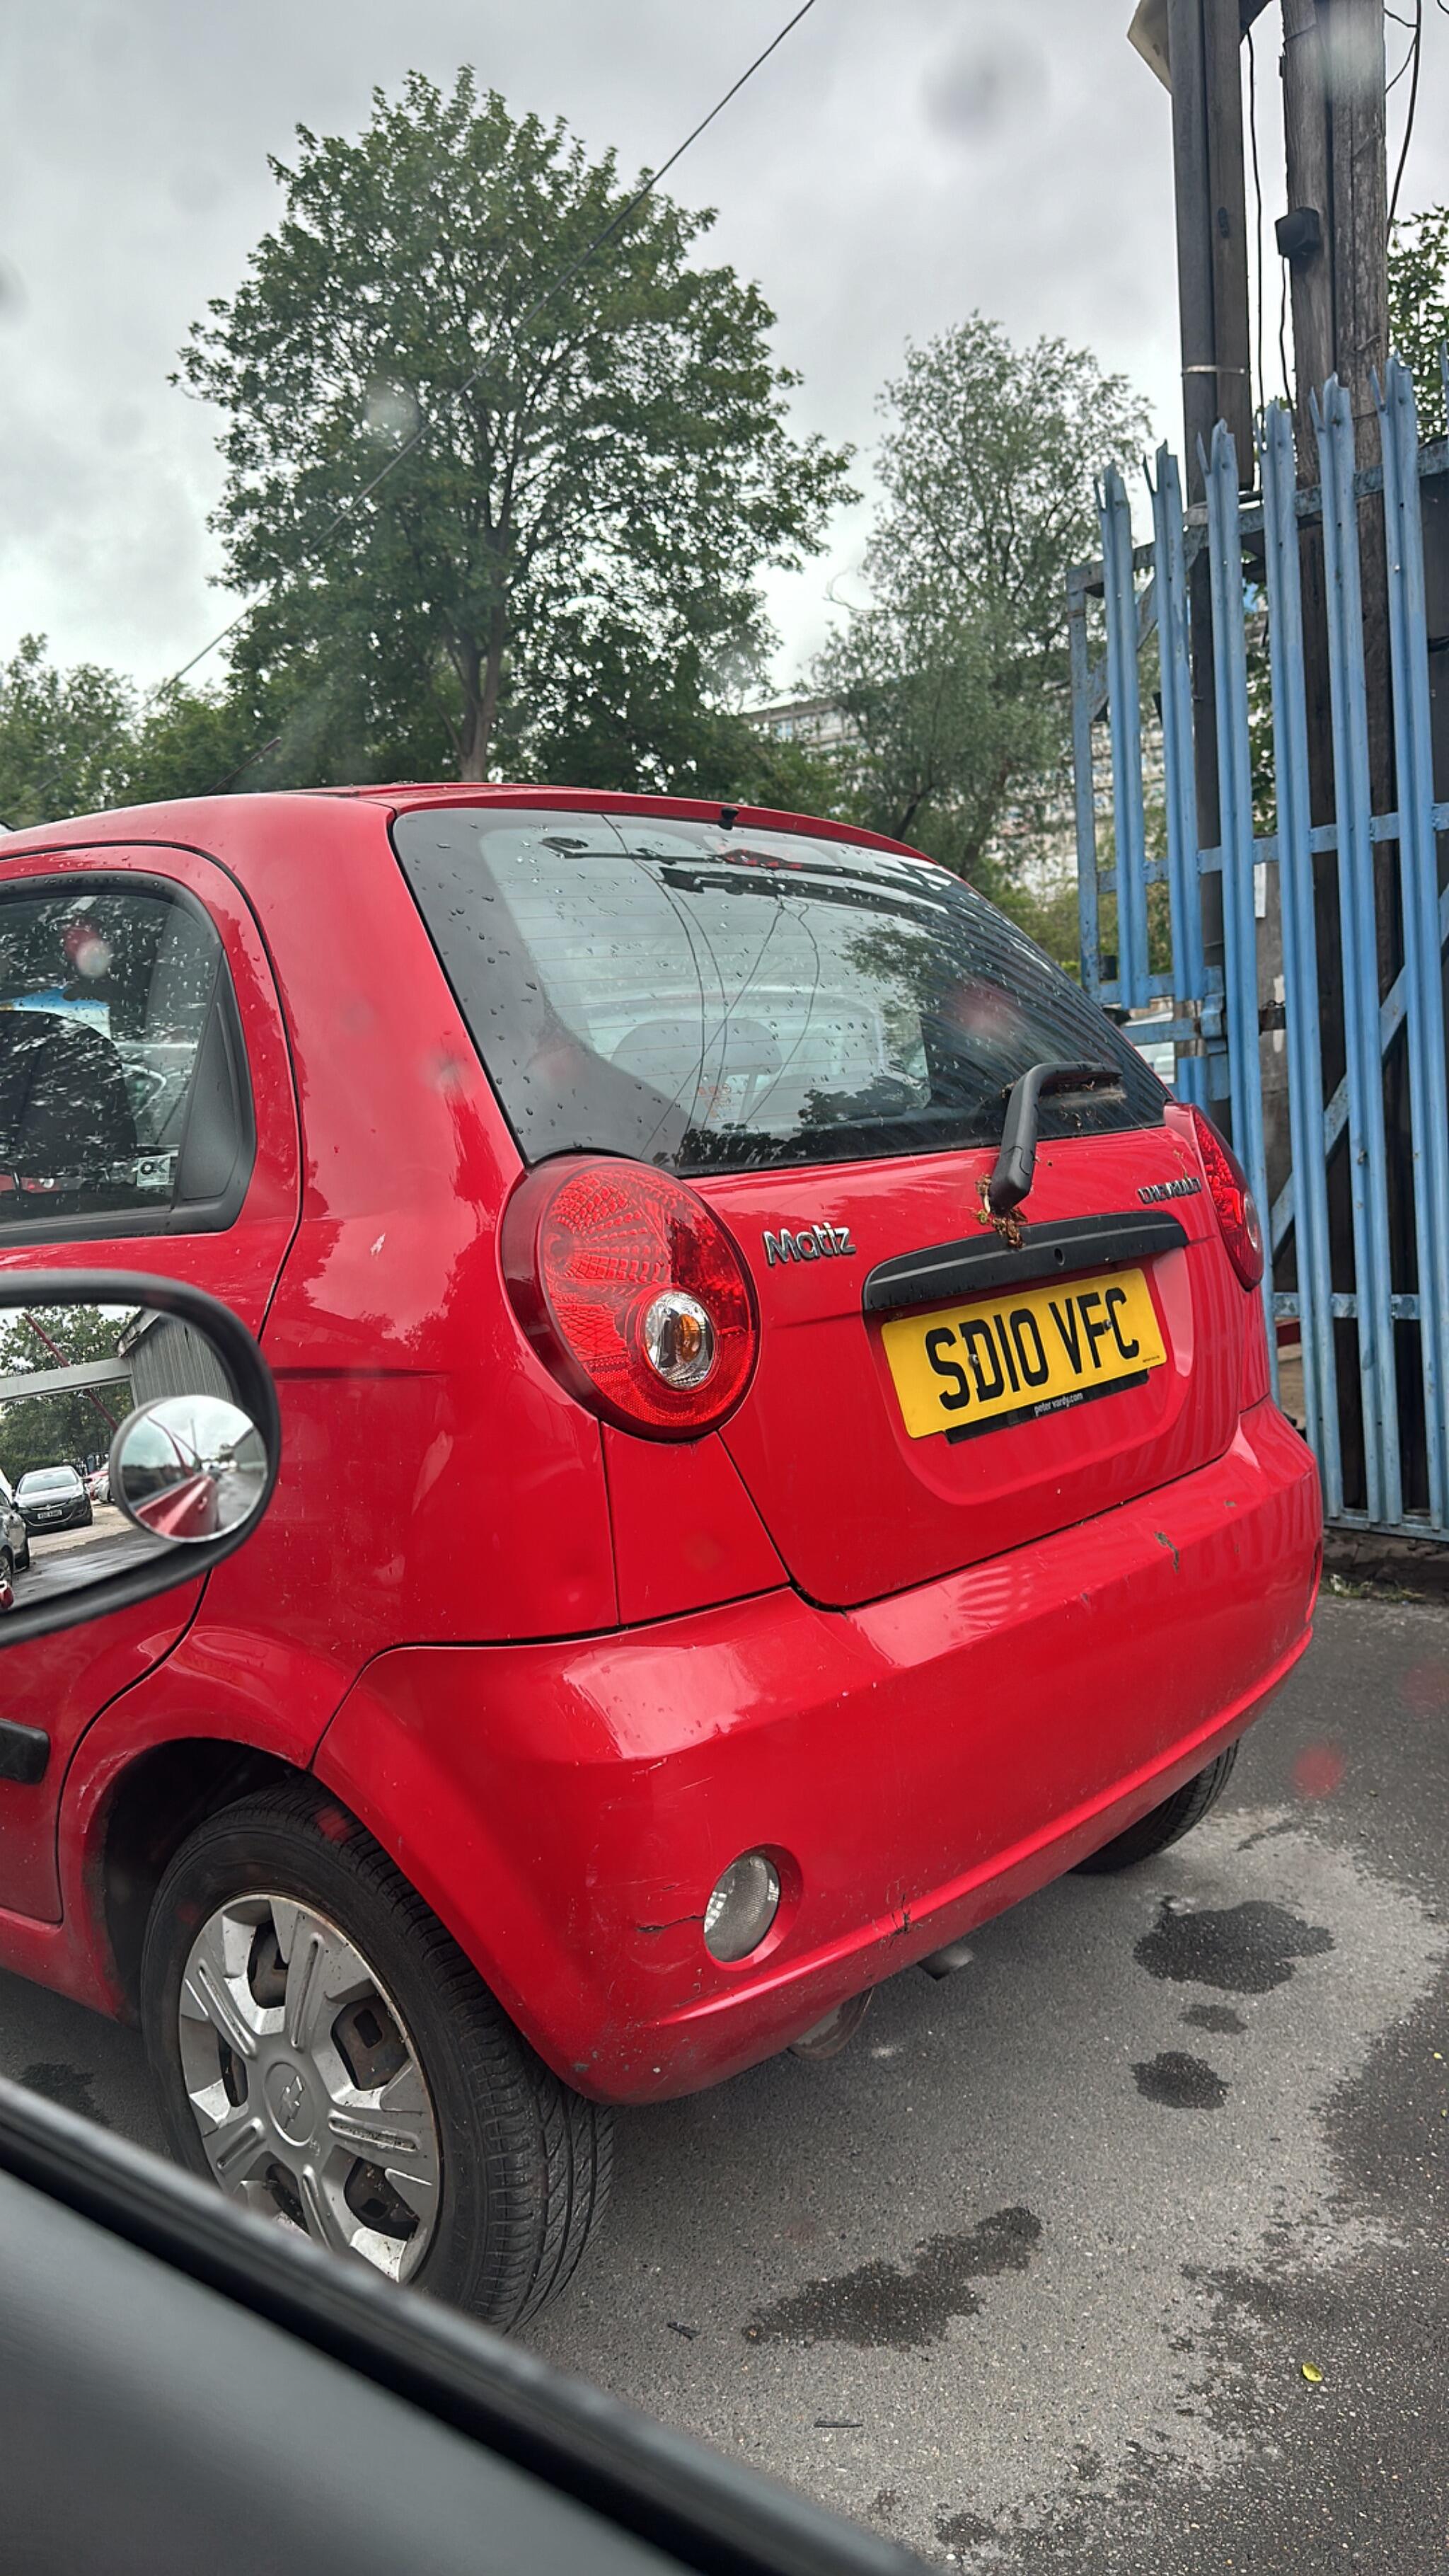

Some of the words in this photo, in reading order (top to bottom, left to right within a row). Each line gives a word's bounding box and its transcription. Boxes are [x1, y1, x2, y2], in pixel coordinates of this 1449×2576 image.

[763, 1221, 856, 1265] Matiz
[925, 1309, 1049, 1410] SD10
[1049, 1287, 1139, 1374] VFC
